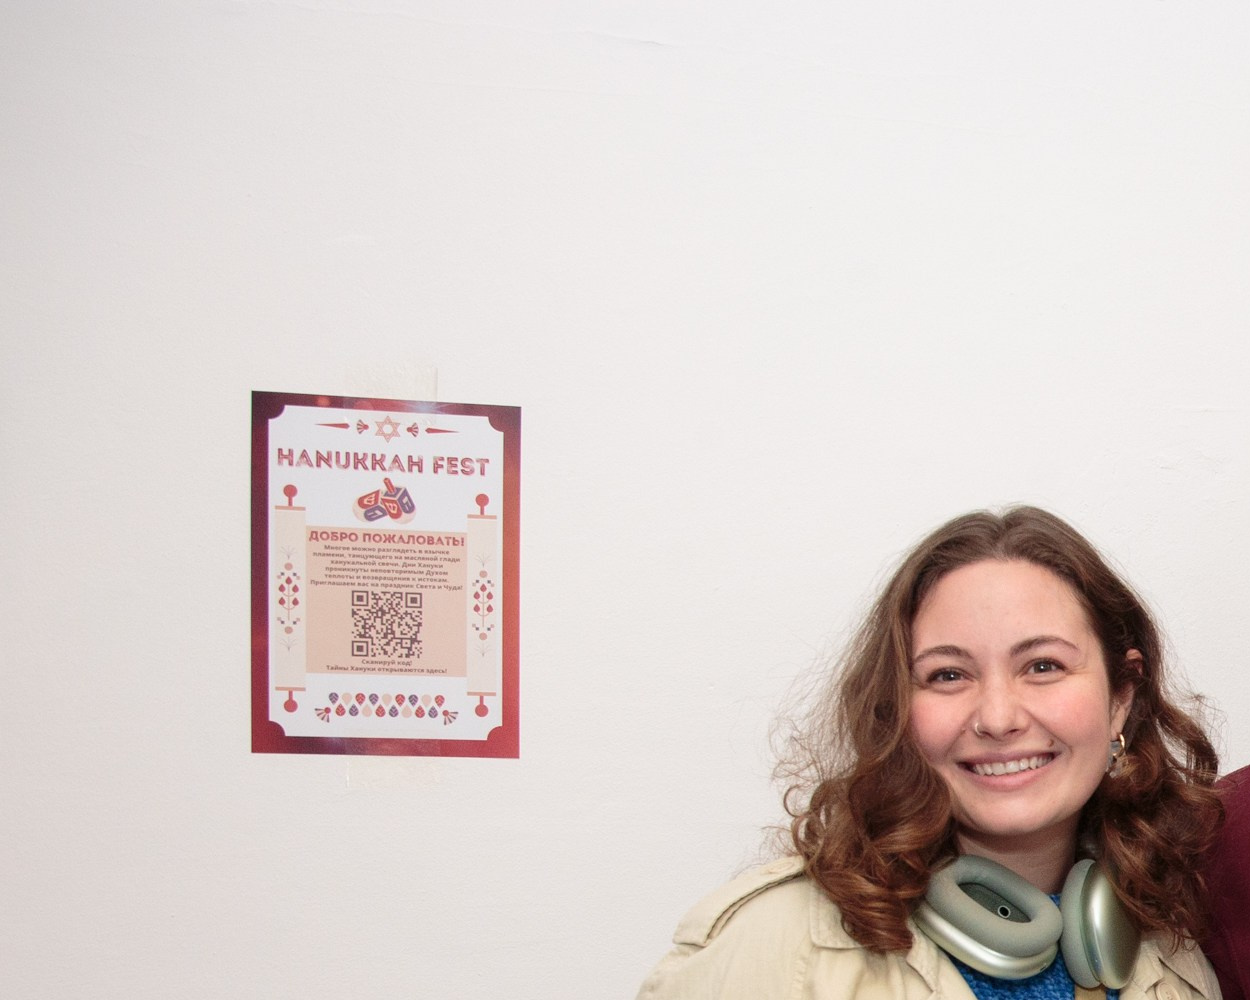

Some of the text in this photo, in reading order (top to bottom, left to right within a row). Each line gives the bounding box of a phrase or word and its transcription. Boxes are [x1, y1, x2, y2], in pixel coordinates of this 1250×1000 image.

[278, 448, 490, 476] HANUKKAH FEST
[309, 531, 464, 546] ДОБРО ПОЖАЛОВАТЬ!
